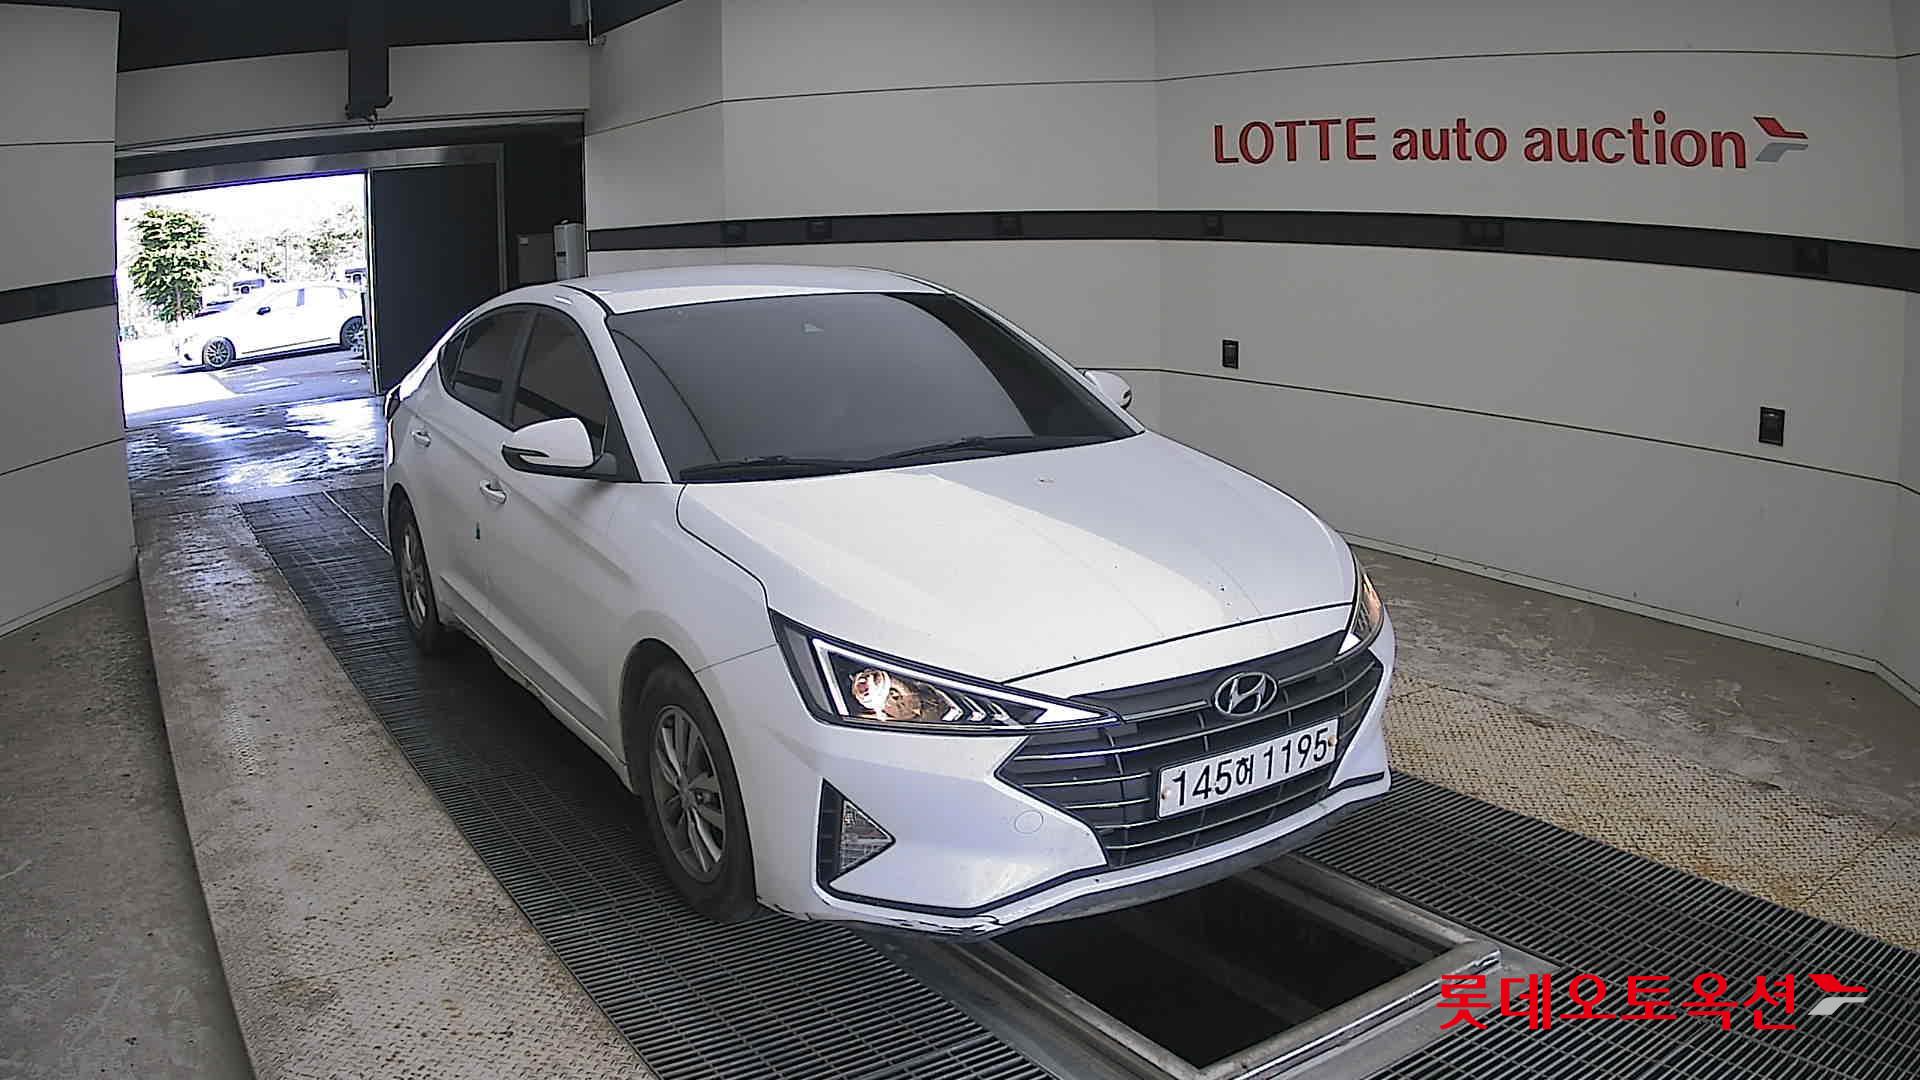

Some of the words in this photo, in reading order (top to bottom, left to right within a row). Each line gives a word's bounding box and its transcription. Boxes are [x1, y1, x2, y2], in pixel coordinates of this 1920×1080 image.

[1214, 116, 1377, 164] LOTTE
[1392, 118, 1508, 162] auto
[1523, 110, 1748, 169] auction
[1263, 727, 1329, 780] 1195
